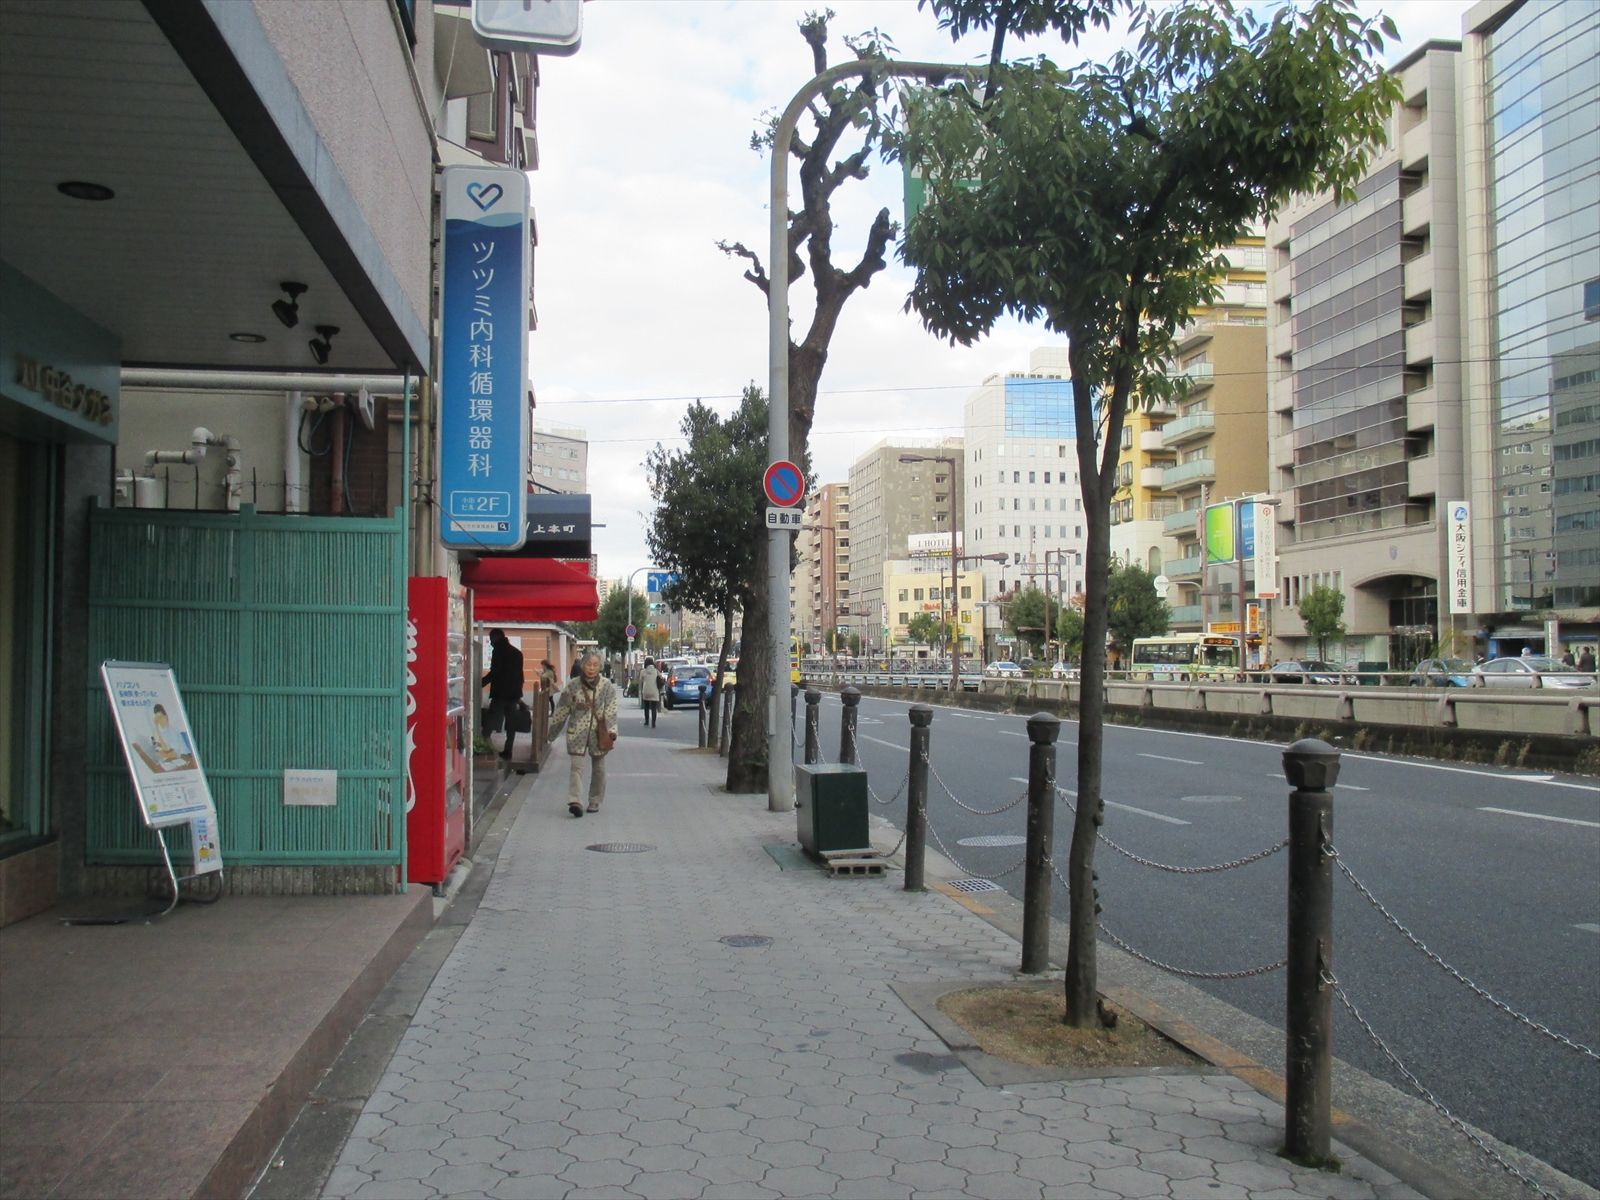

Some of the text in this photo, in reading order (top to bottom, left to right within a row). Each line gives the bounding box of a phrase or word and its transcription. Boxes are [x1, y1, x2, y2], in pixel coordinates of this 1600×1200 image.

[468, 241, 495, 478] ツツミ内科循環器科
[477, 496, 500, 511] 2F
[768, 513, 802, 525] 自動車
[1455, 523, 1468, 608] 大阪シティ信用金庫
